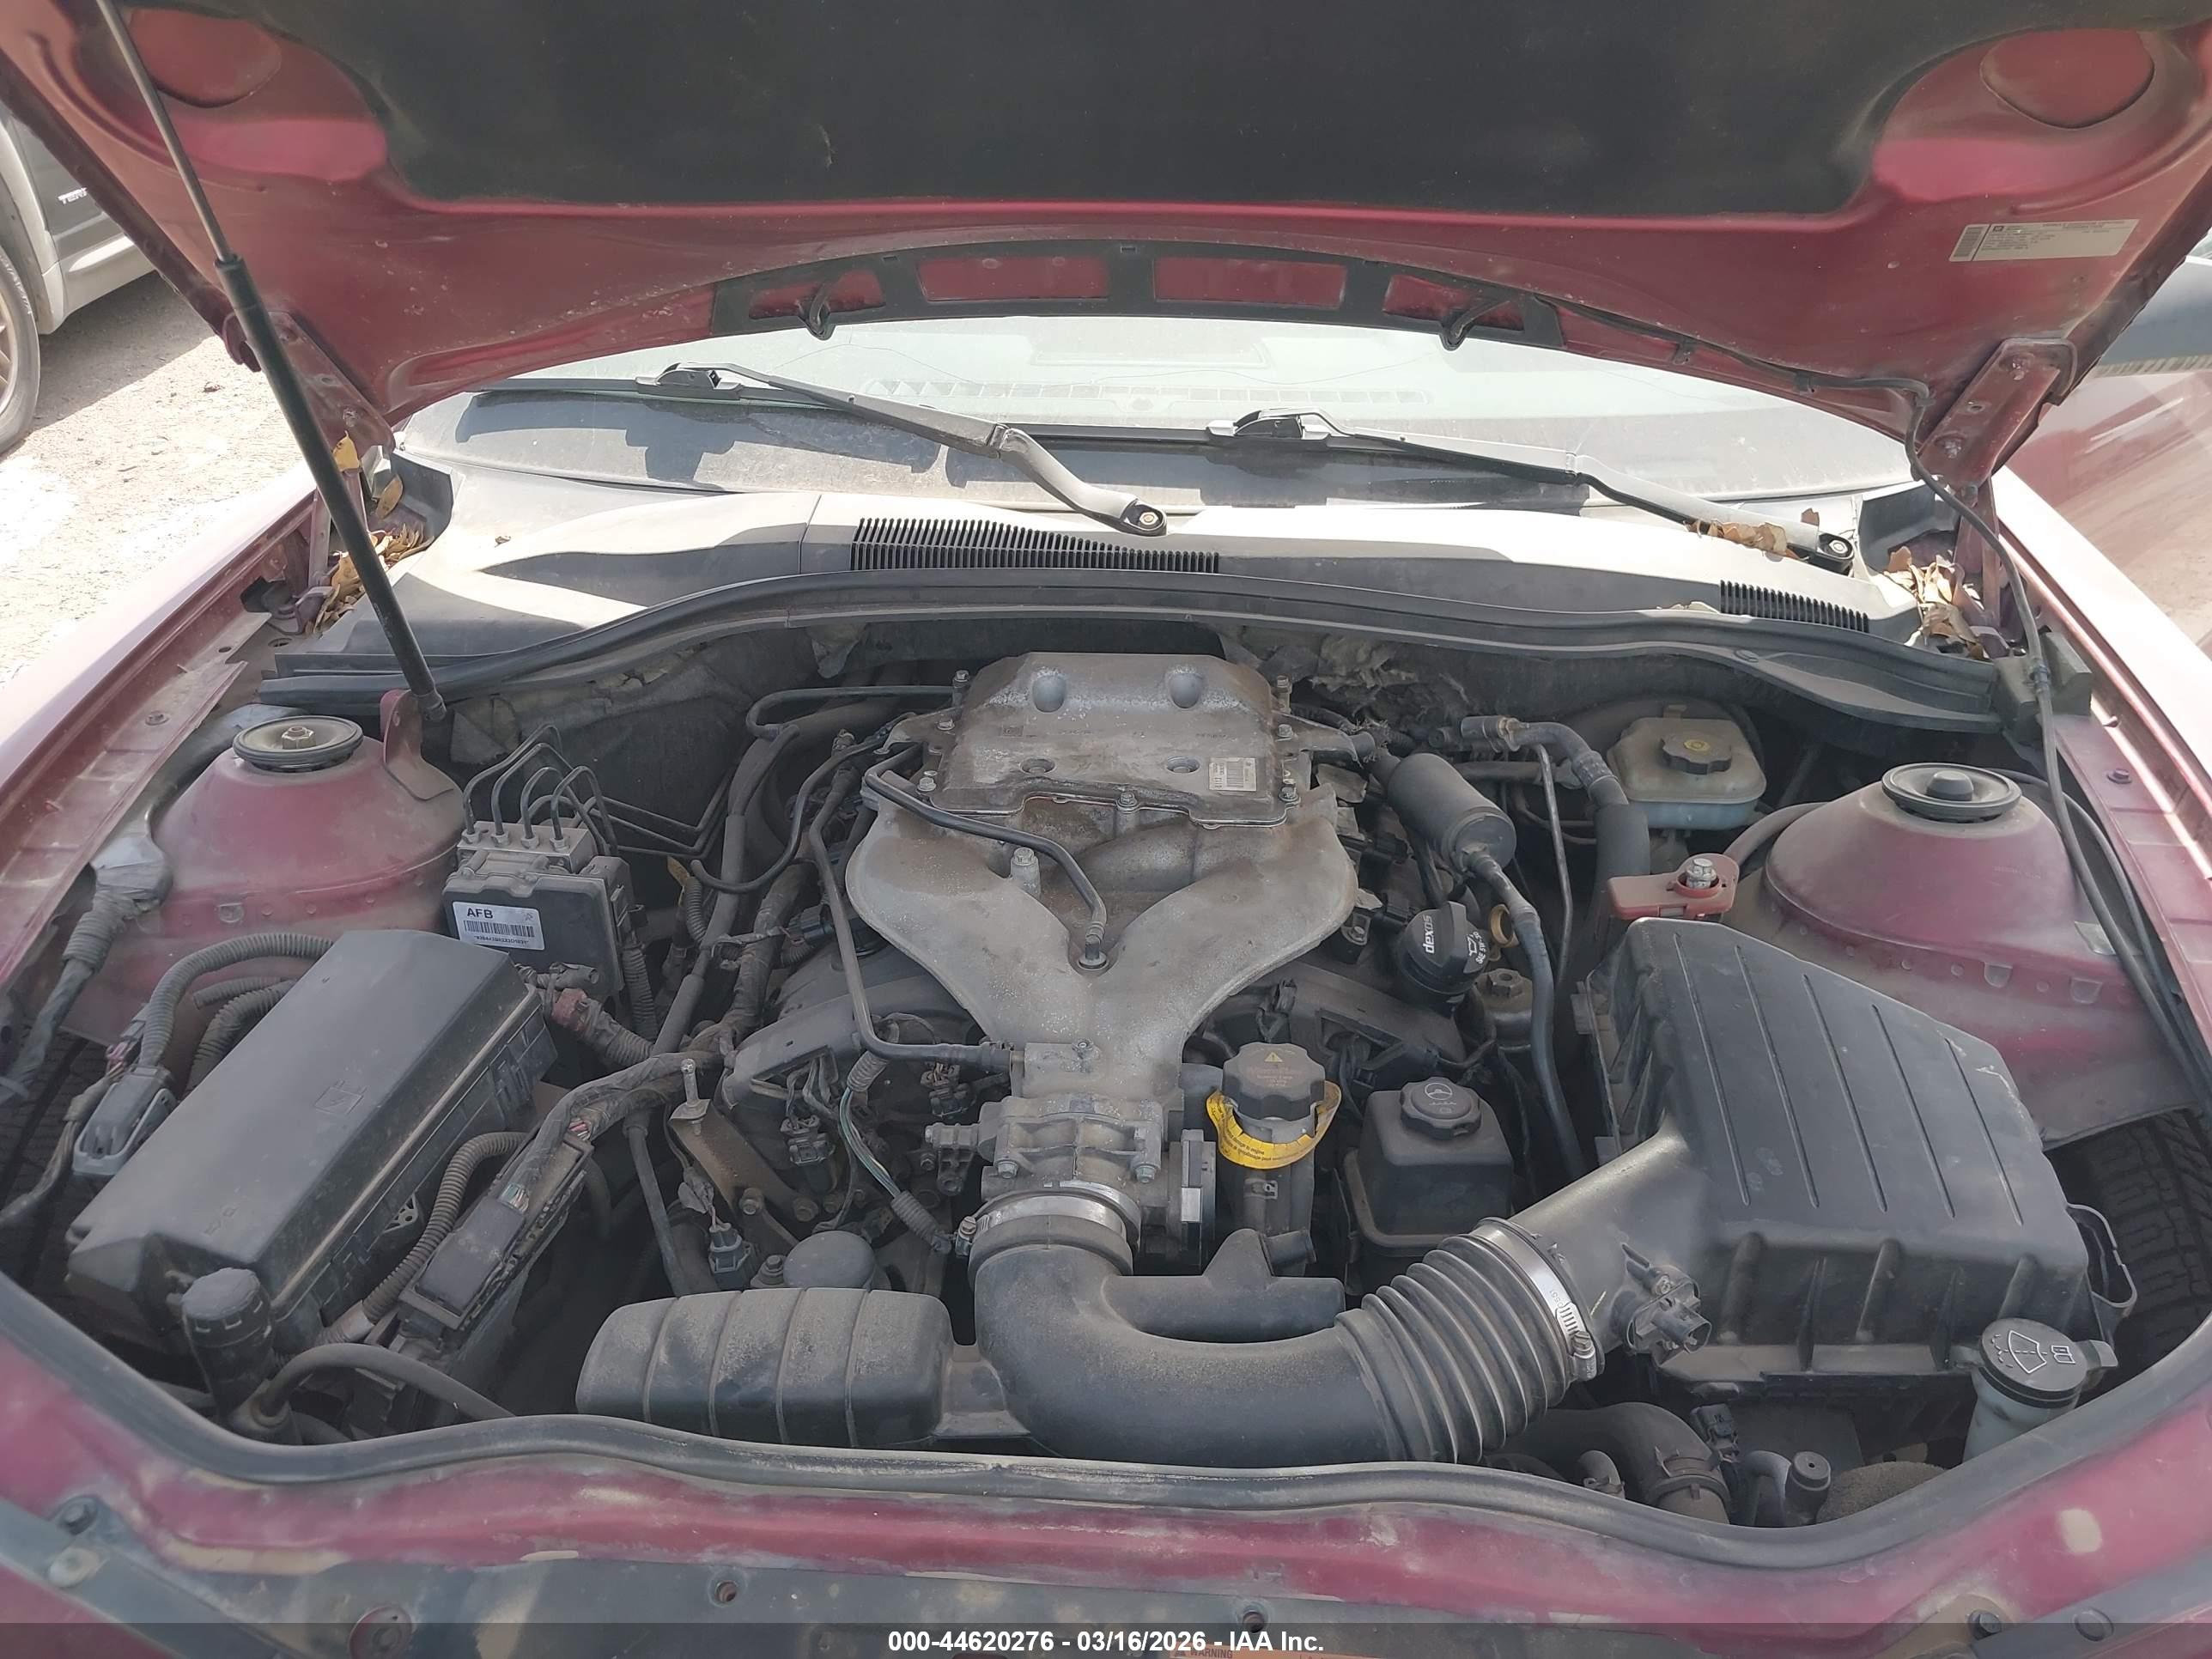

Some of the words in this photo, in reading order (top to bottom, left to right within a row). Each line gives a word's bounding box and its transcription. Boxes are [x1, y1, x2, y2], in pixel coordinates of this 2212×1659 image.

[466, 908, 494, 919] AFB
[1422, 915, 1436, 954] dexos
[1190, 1649, 1233, 1658] WARNING
